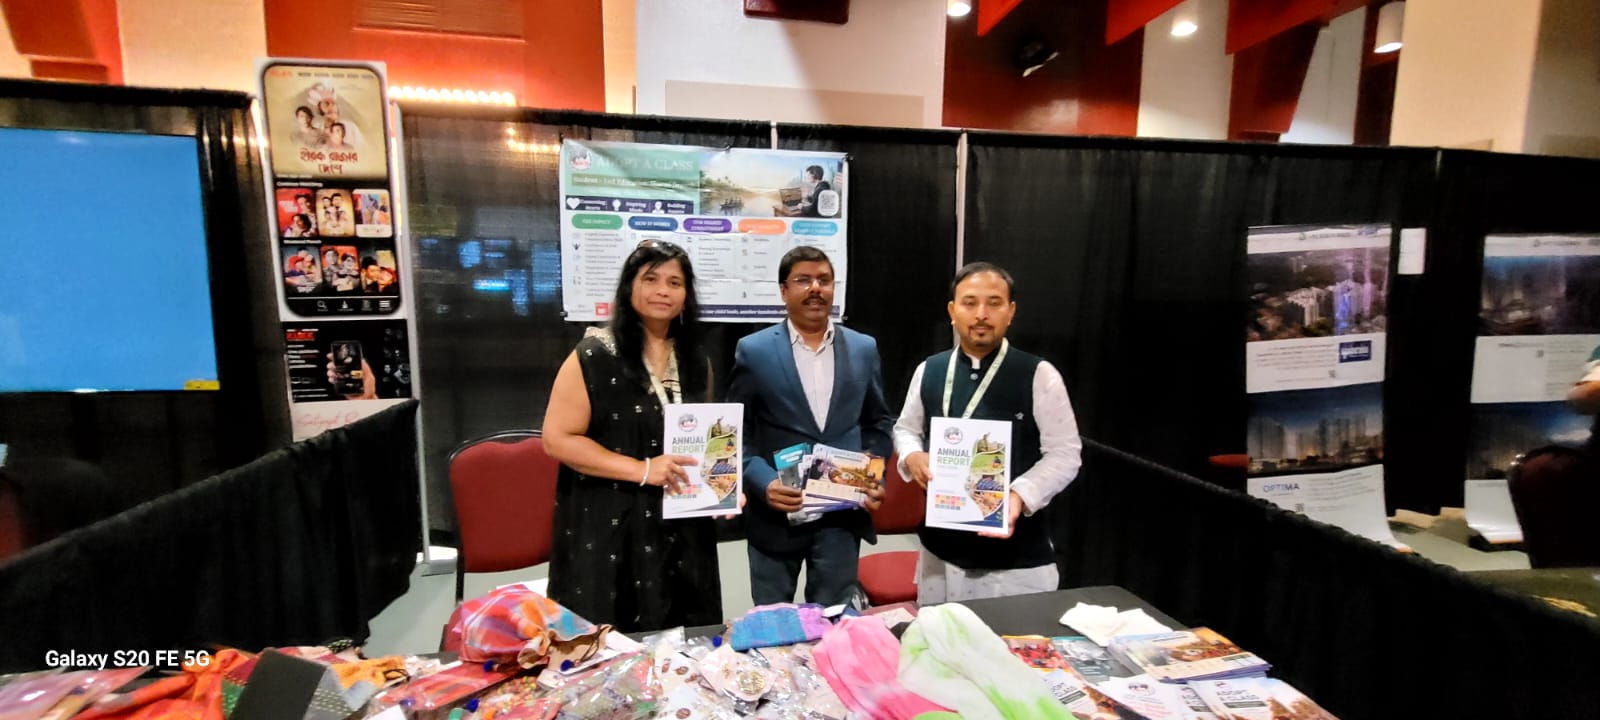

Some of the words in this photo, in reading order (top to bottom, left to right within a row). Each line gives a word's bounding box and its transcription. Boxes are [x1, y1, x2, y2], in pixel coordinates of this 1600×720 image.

[655, 159, 695, 170] CLASS
[672, 436, 705, 445] ANNUAL
[672, 445, 704, 453] REPORT
[937, 447, 970, 458] ANNUAL
[937, 456, 970, 466] REPORT
[1263, 483, 1300, 493] OPTIMA
